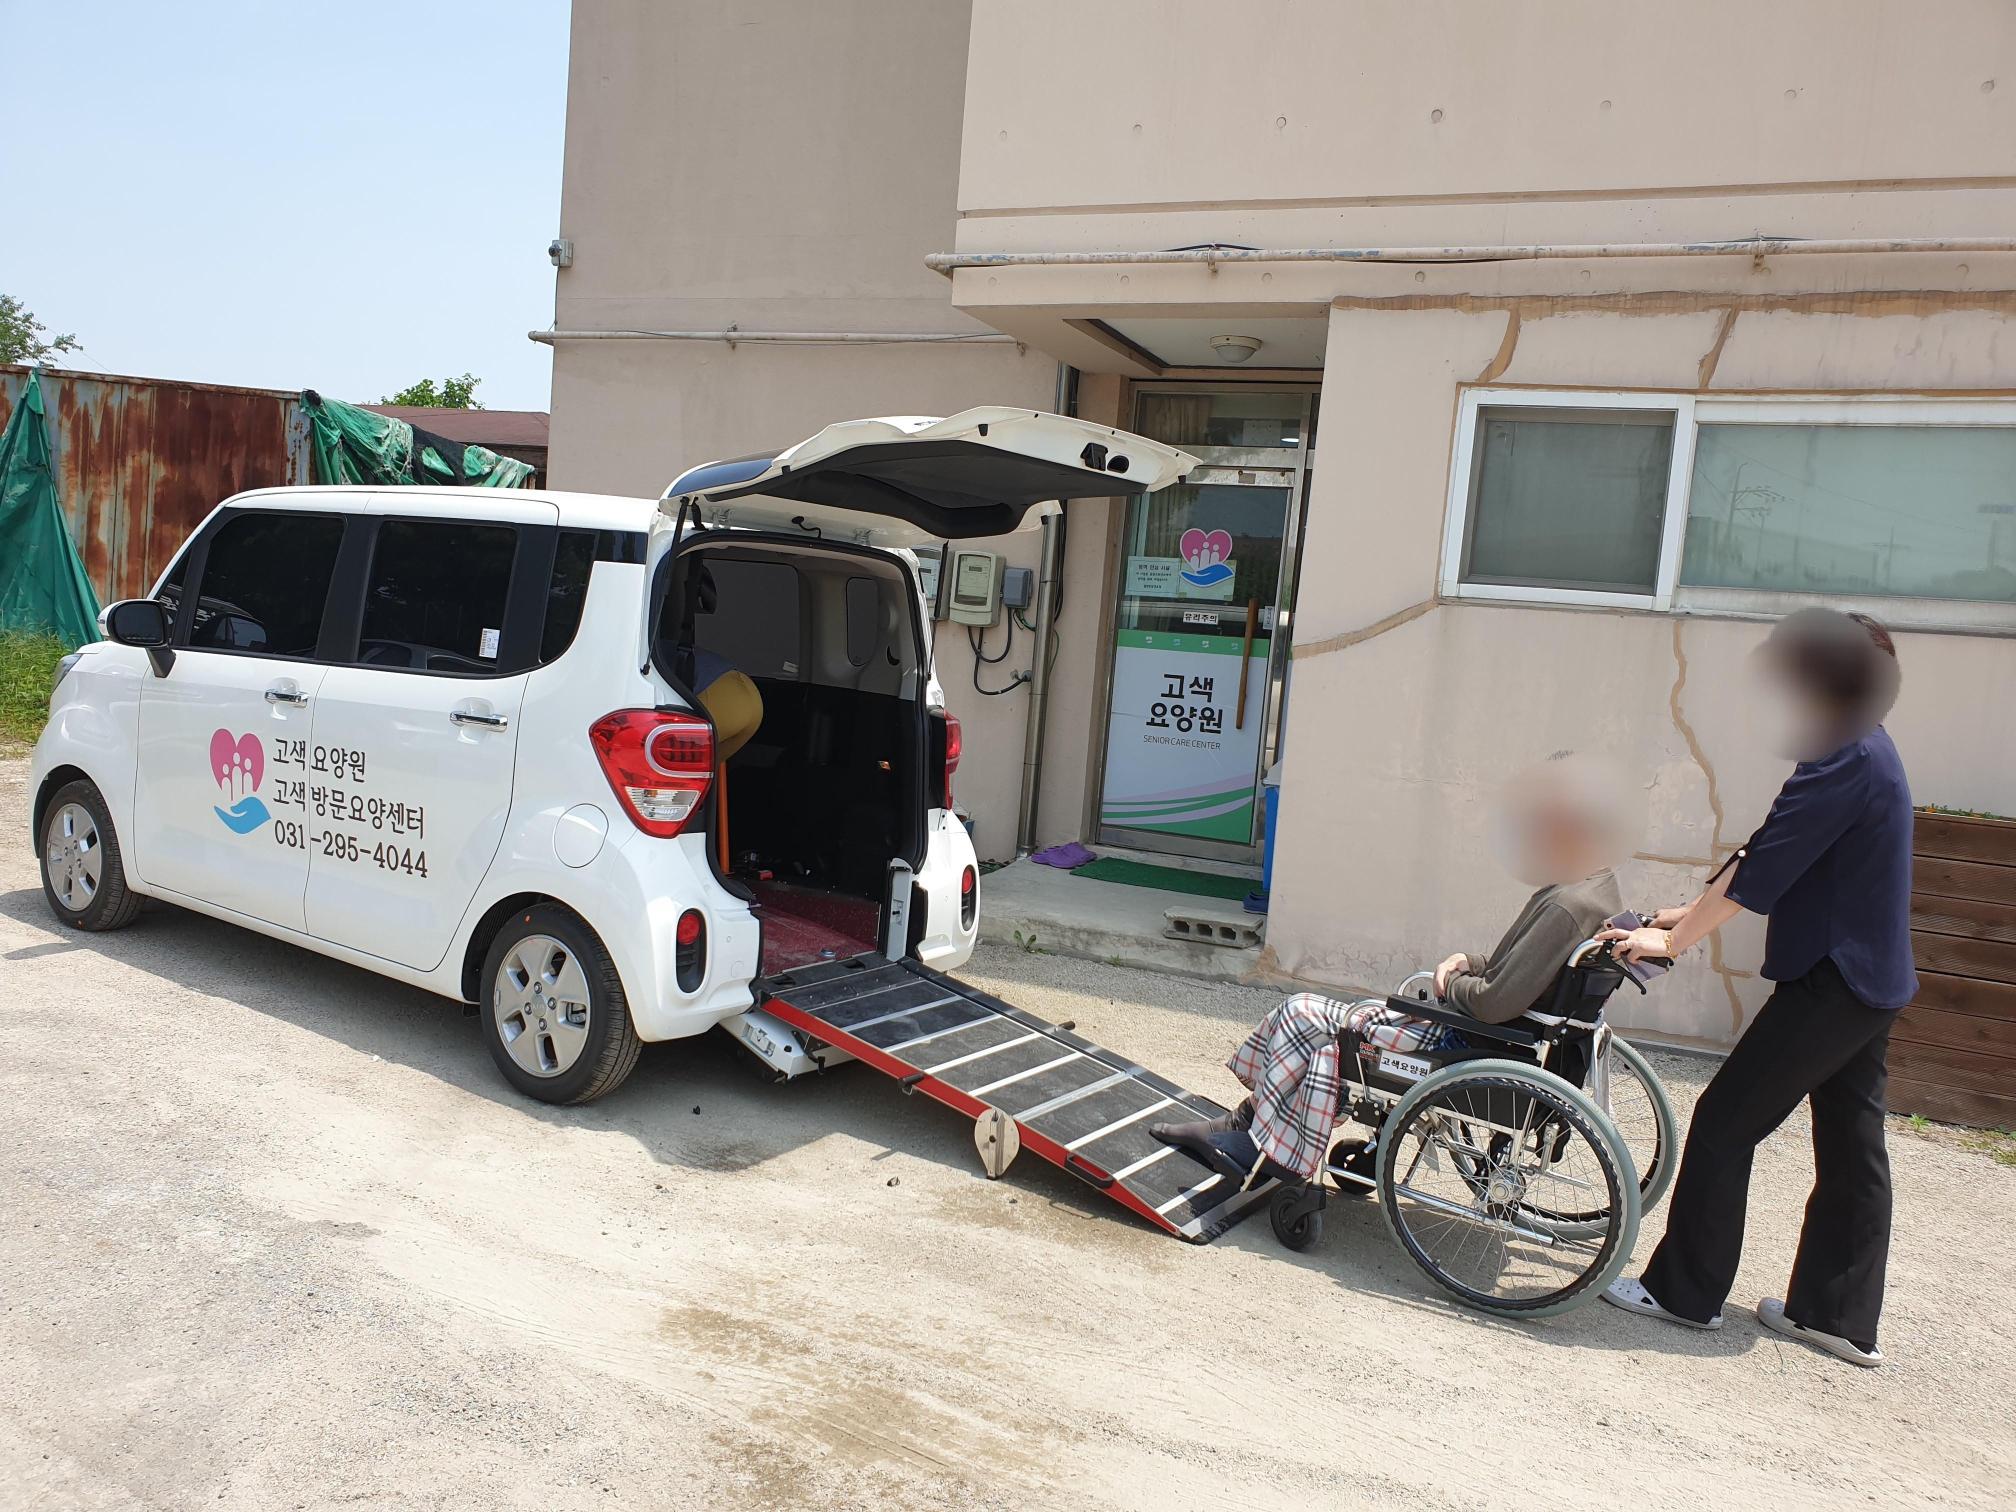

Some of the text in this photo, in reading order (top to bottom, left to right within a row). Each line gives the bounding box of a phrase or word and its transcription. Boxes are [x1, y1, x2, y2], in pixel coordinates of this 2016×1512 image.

[1184, 613, 1217, 623] 유리주의
[1161, 673, 1214, 703] 고색
[1146, 702, 1223, 734] 요양원
[1143, 735, 1221, 750] SENIOR CARE CENTER
[273, 738, 366, 783] 고색 요양원
[273, 778, 424, 840] 고색 방문요양센터
[274, 819, 428, 879] 031-295-4044
[1382, 1057, 1428, 1077] 고색요양원
